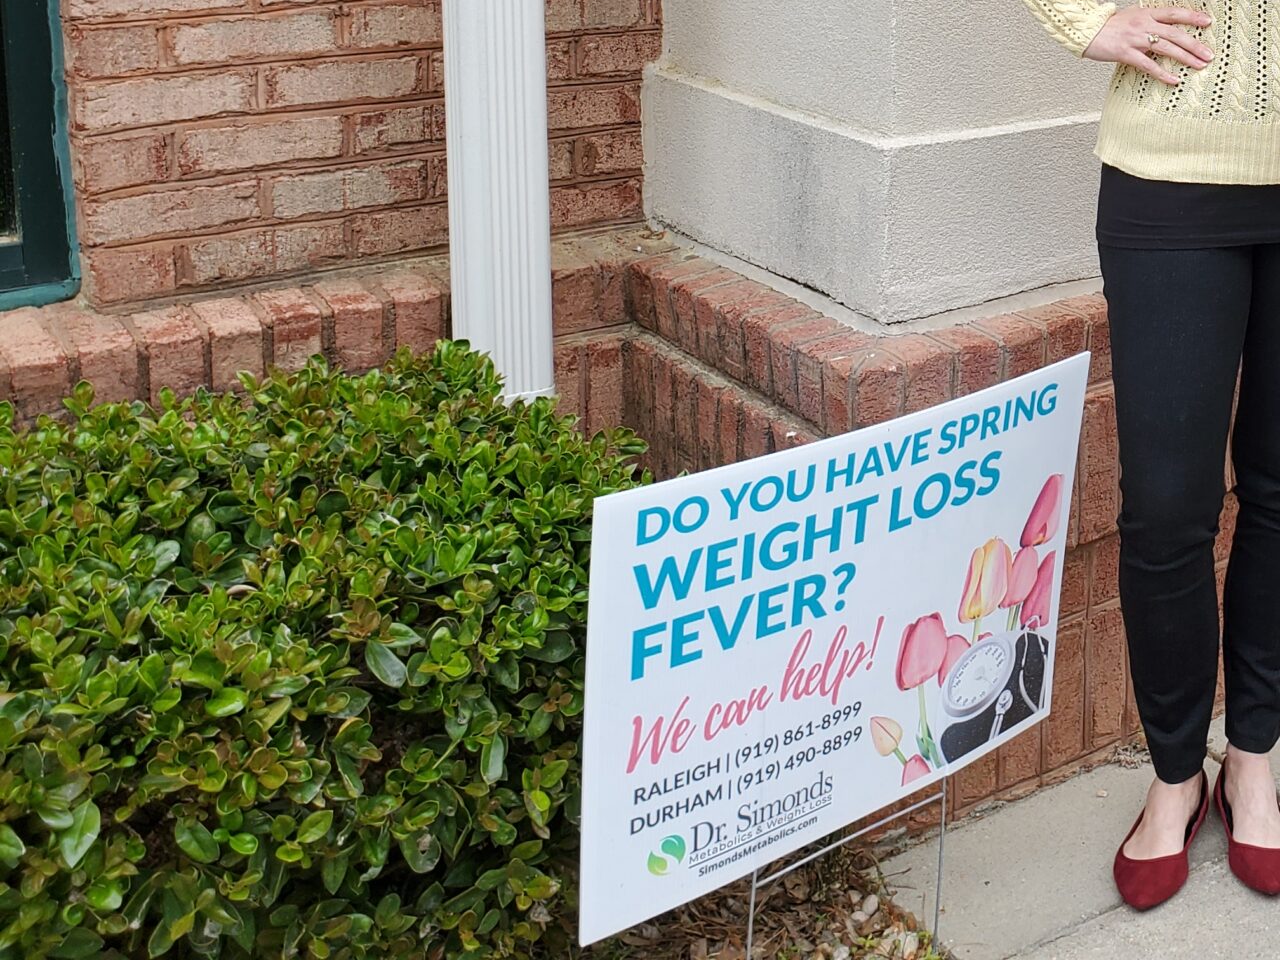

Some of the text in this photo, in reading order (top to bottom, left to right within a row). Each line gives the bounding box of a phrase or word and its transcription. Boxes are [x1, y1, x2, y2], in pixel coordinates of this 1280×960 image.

[636, 382, 1060, 547] DO YOU HAVE SPRING
[632, 450, 1004, 611] WEIGHT LOSS
[630, 561, 857, 682] FEVER?
[625, 695, 697, 774] We
[703, 685, 774, 742] can
[779, 615, 885, 706] help!
[629, 787, 723, 836] DURHAM
[736, 760, 781, 795] (919)
[783, 726, 863, 771] 490-8899
[632, 760, 721, 805] RALEIGH
[734, 734, 780, 768] (919)
[783, 700, 862, 747] 861-8999
[688, 794, 833, 865] Metabolics & Weight Loss
[689, 770, 834, 855] Dr. Simonds
[697, 814, 818, 878] SimondsMetabolics.com
